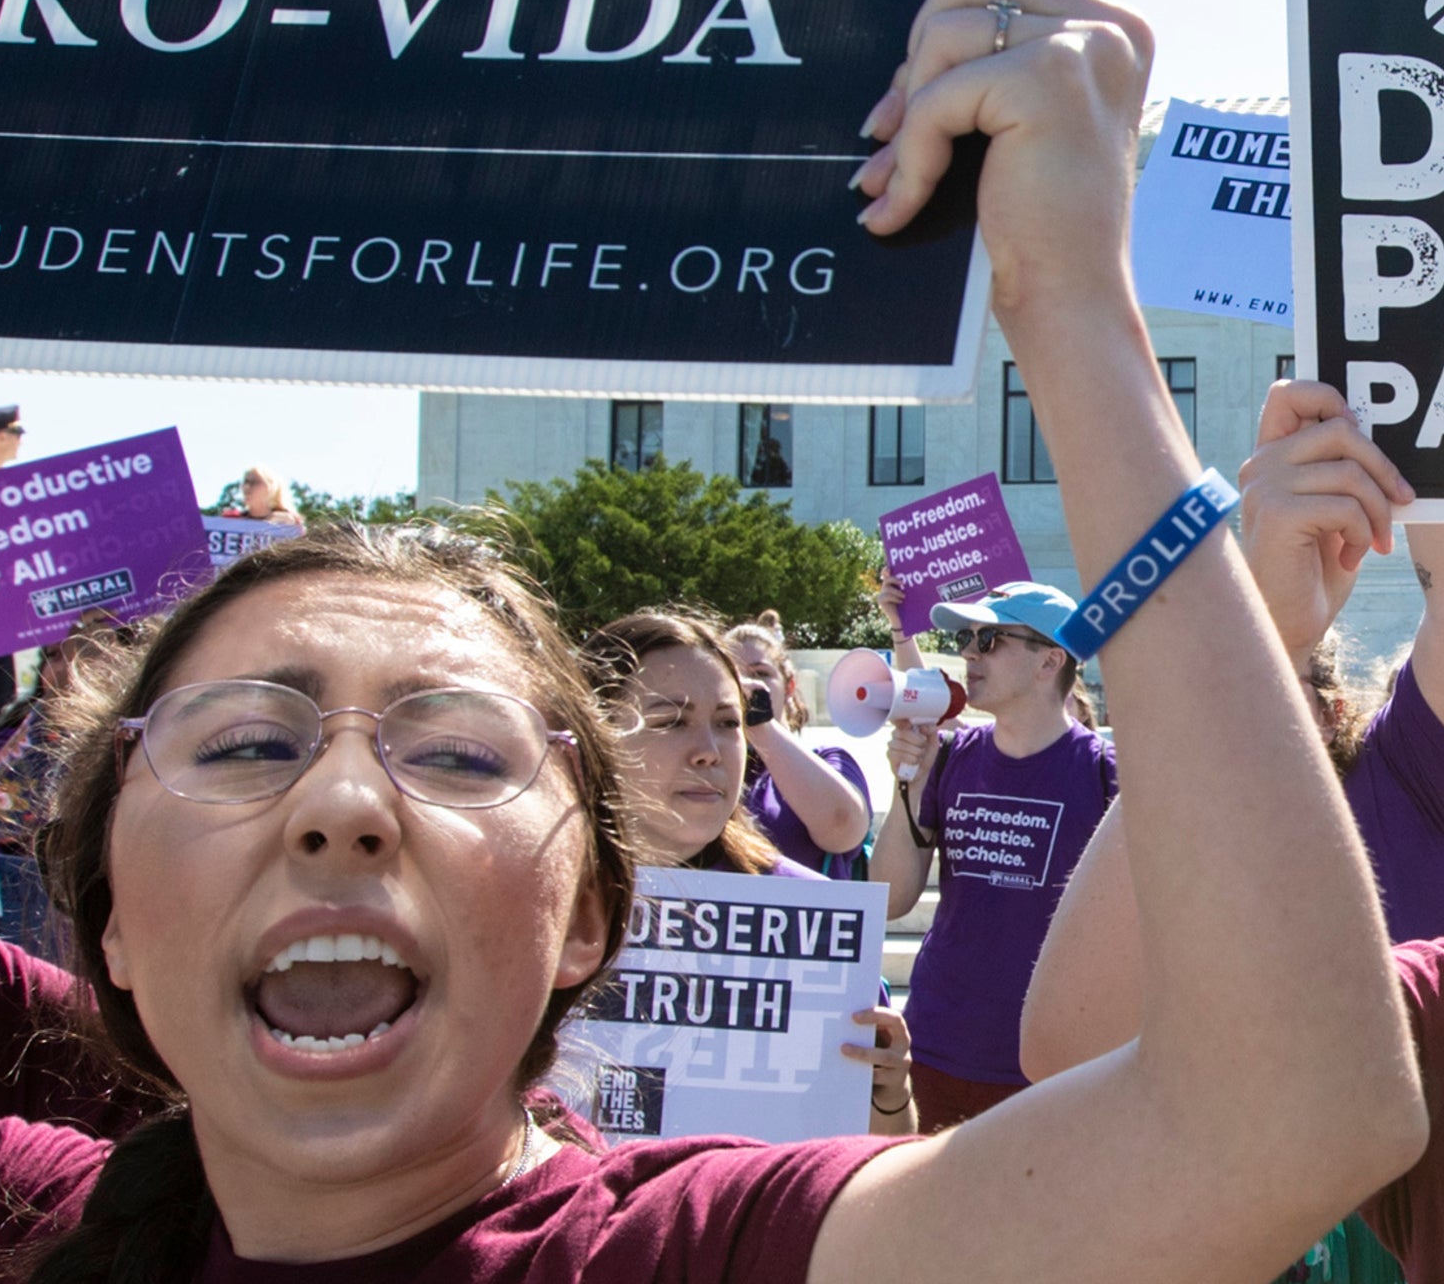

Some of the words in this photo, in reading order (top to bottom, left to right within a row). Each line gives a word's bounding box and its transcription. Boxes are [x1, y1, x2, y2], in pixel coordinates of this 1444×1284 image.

[1179, 126, 1291, 167] WOME
[1194, 289, 1288, 315] WWW.END
[885, 492, 986, 540] Pro-Freedom.
[890, 522, 984, 566] Pro-Justice.
[1082, 485, 1226, 635] PROLIFE
[12, 549, 69, 587] All.
[896, 549, 988, 590] Pro-Choice.
[951, 575, 982, 592] NARAL
[60, 575, 129, 604] NARAL
[946, 807, 1051, 830] Pro-Freedom.
[945, 827, 1036, 848] Pro-Justice.
[627, 898, 858, 959] DESERVE
[620, 973, 784, 1030] TRUTH
[599, 1069, 637, 1091] END
[600, 1090, 635, 1111] THE
[598, 1109, 646, 1131] LIES
